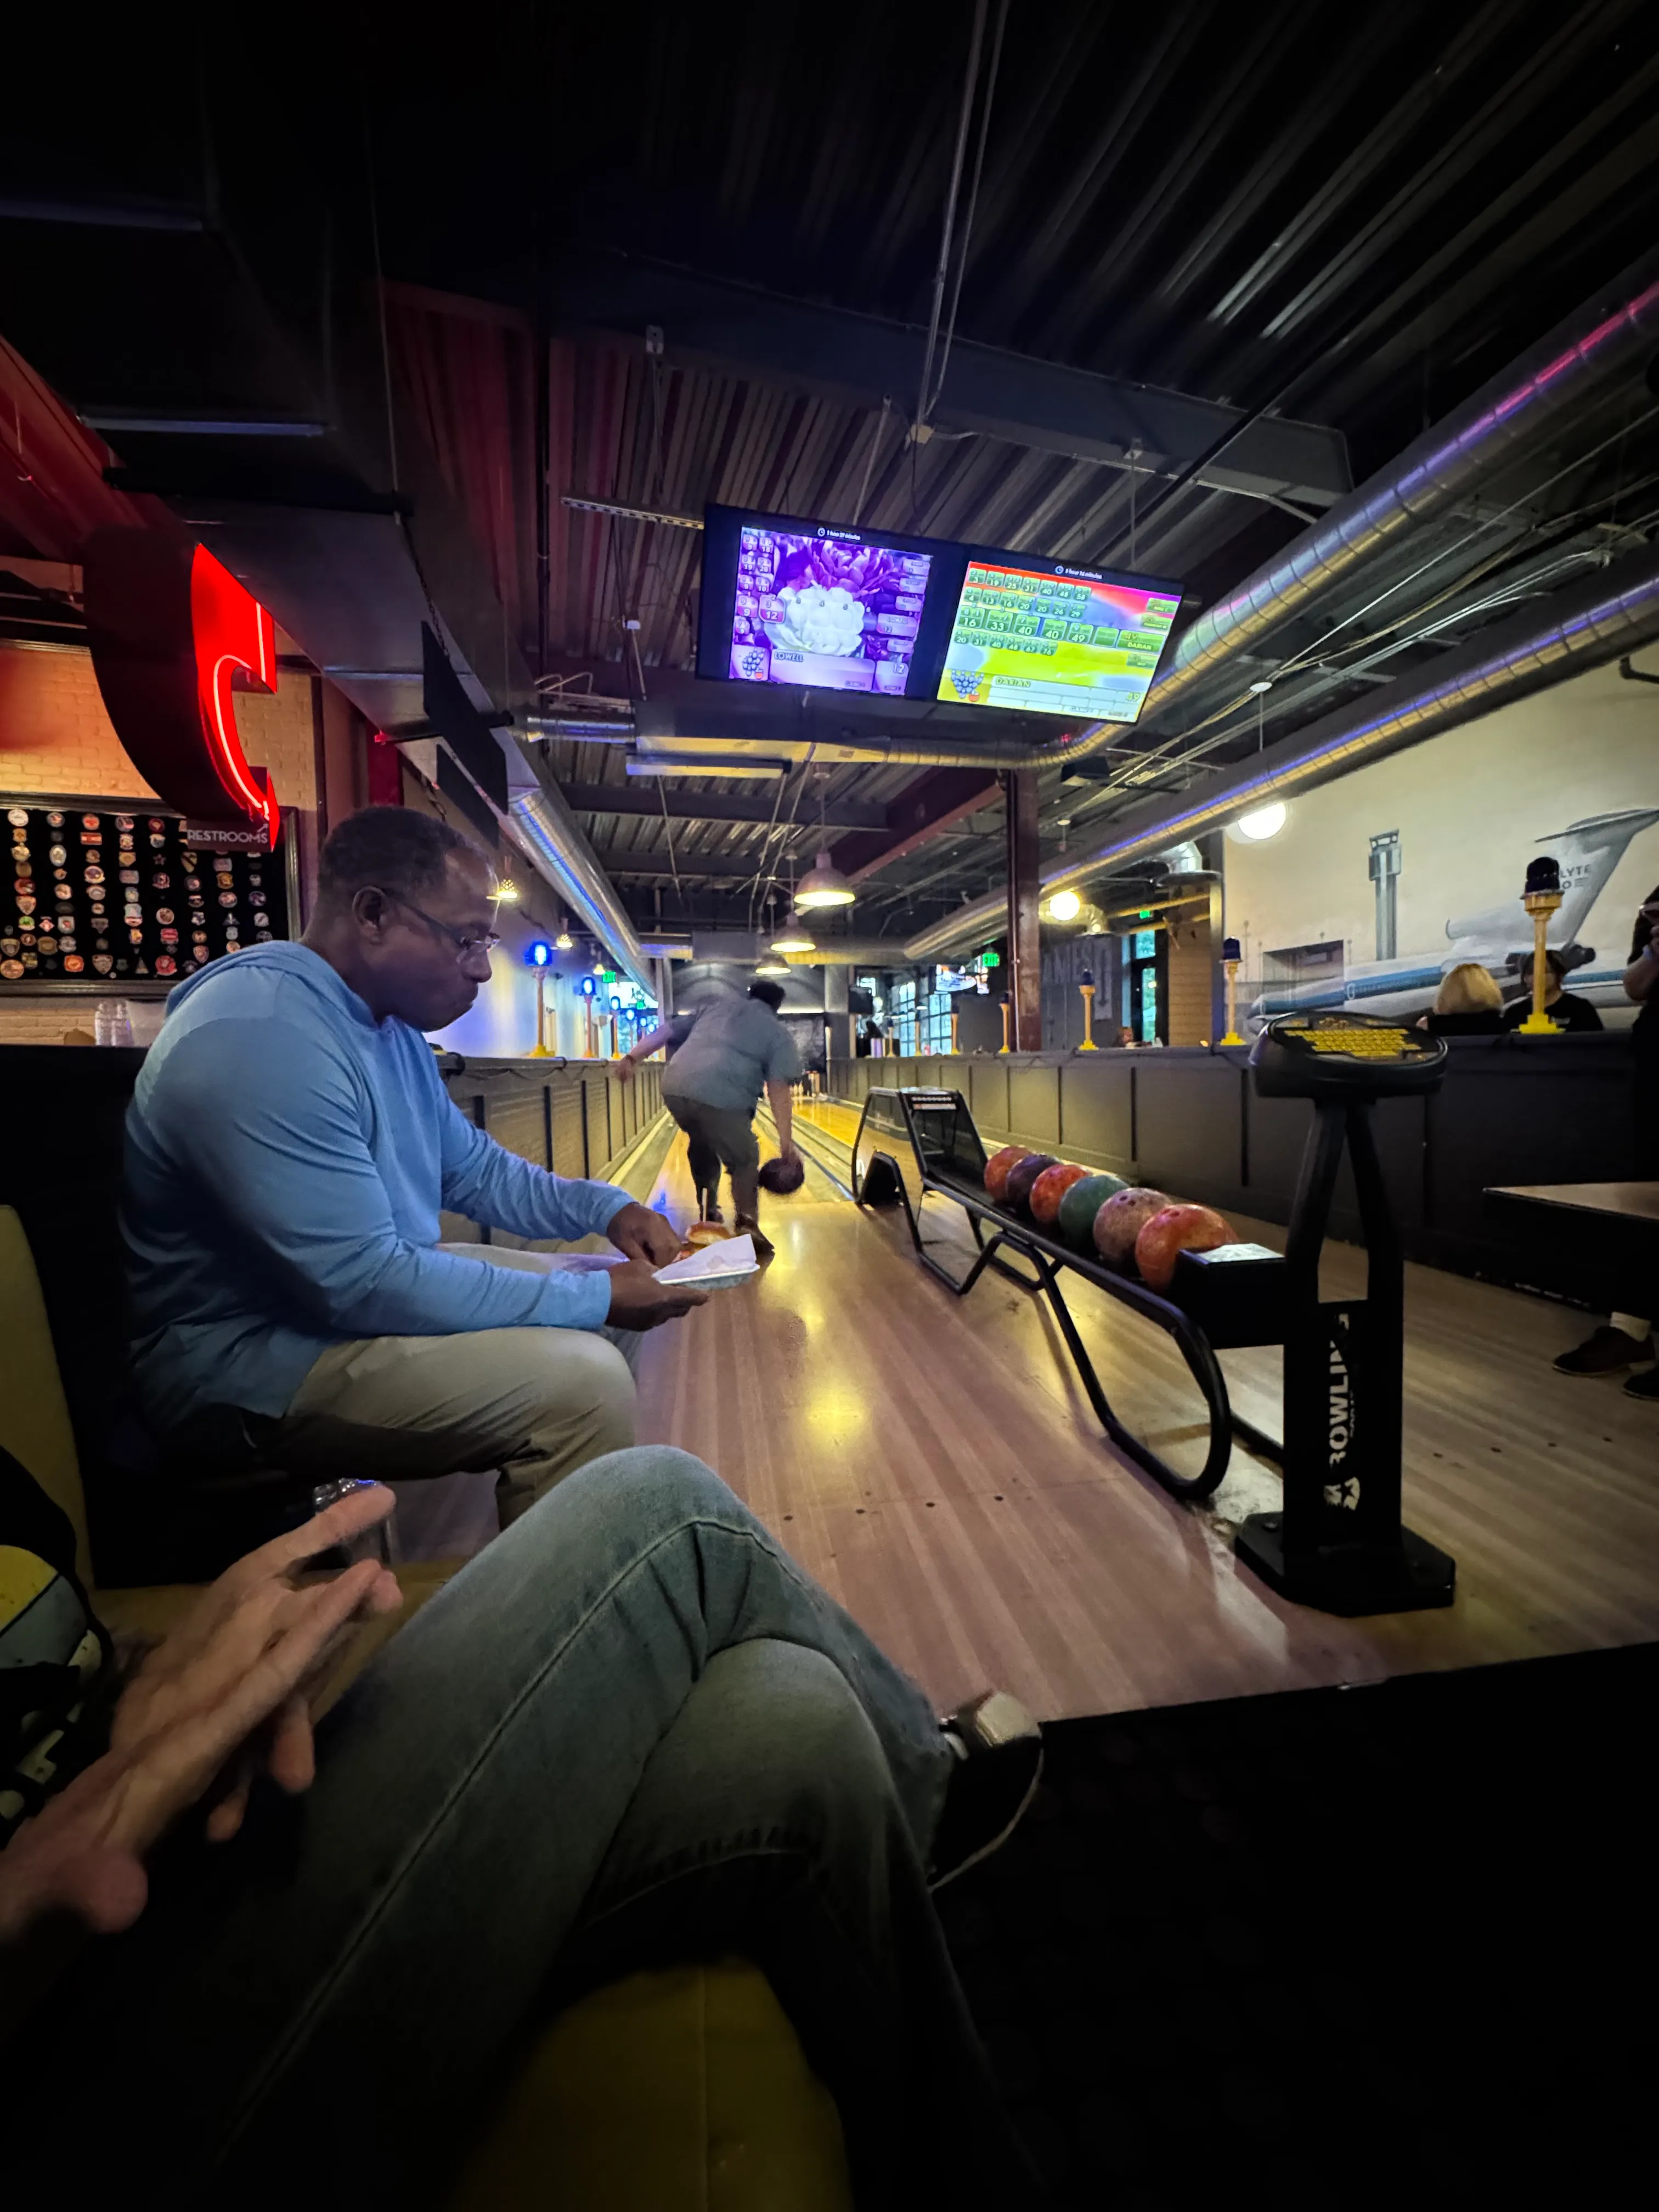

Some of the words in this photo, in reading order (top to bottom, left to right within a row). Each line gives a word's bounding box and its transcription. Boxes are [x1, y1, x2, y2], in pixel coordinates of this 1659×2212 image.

[743, 608, 751, 618] 9
[765, 610, 778, 620] 12
[963, 617, 977, 627] 16
[990, 622, 1005, 631] 33
[1018, 626, 1032, 635] 40
[1045, 630, 1059, 639] 40
[1071, 634, 1085, 642] 49
[1127, 641, 1152, 650] DARIAN
[774, 652, 804, 663] LOWELL
[893, 663, 905, 674] 12
[995, 677, 1031, 687] DARIAN
[1125, 693, 1141, 702] 49
[187, 829, 268, 844] RESTROOMS
[1560, 864, 1592, 878] LYTE
